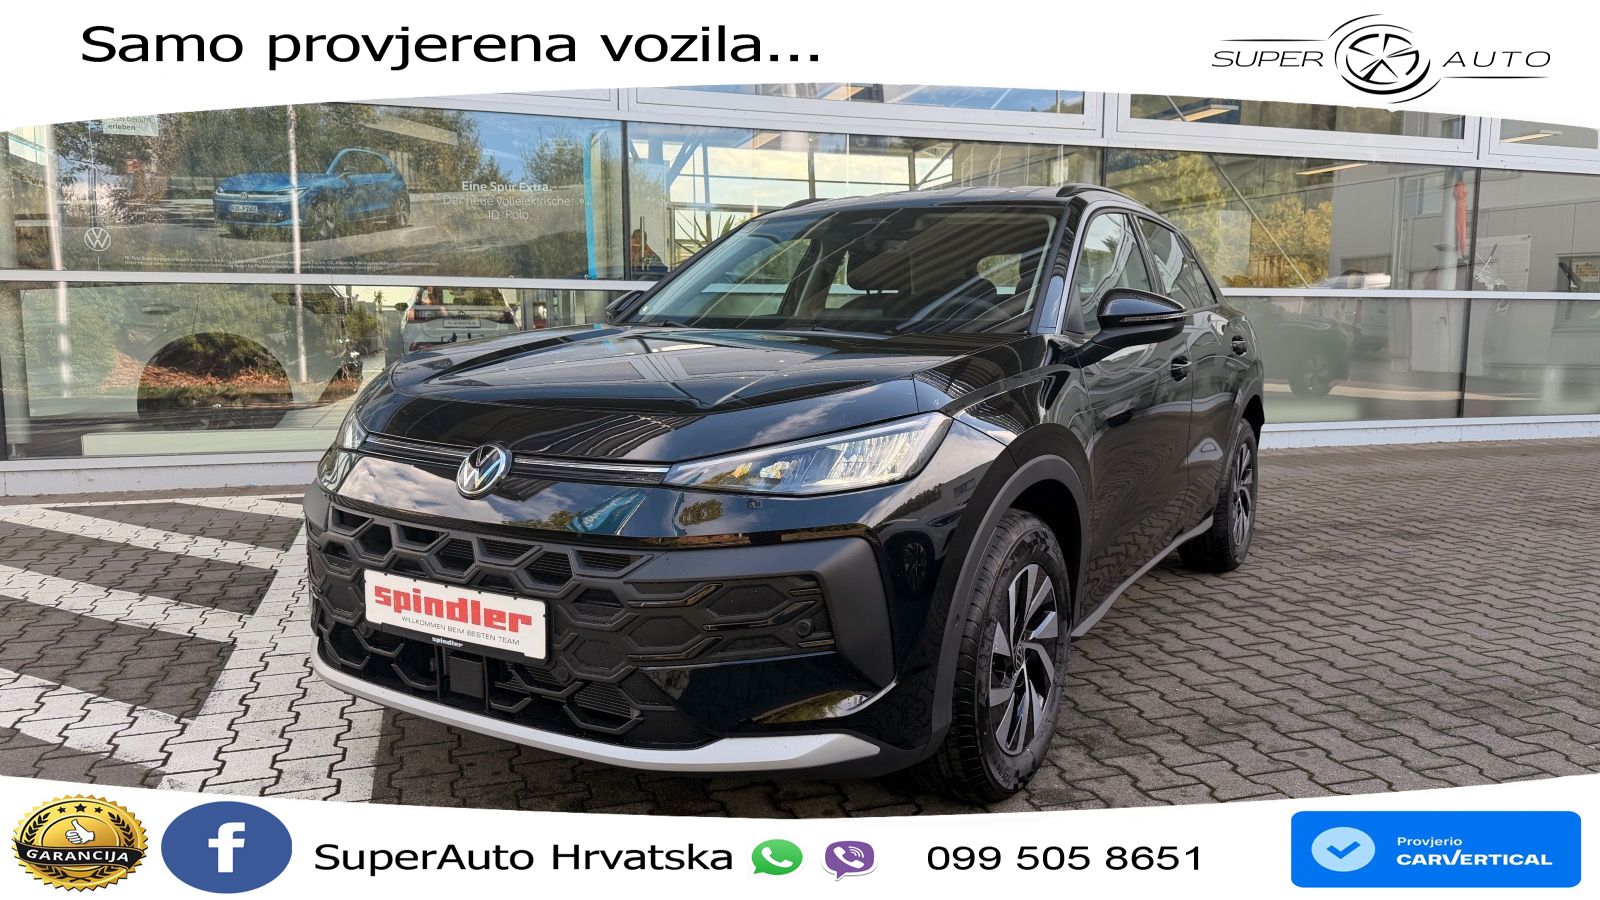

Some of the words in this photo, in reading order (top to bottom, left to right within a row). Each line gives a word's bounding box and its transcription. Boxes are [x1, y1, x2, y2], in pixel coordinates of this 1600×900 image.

[108, 123, 136, 131] erleben
[461, 181, 487, 192] Eine
[489, 181, 516, 193] Spur
[519, 182, 552, 192] Extra.
[443, 195, 463, 205] Der
[466, 196, 493, 206] neue
[496, 196, 571, 207] vollelektrische
[505, 210, 529, 220] Polo
[374, 585, 532, 633] spindler
[401, 615, 446, 631] WILLKOMMEN
[447, 623, 465, 635] BEIM
[466, 628, 497, 641] BESTEN
[498, 635, 520, 646] TEAM
[431, 636, 464, 648] spindler
